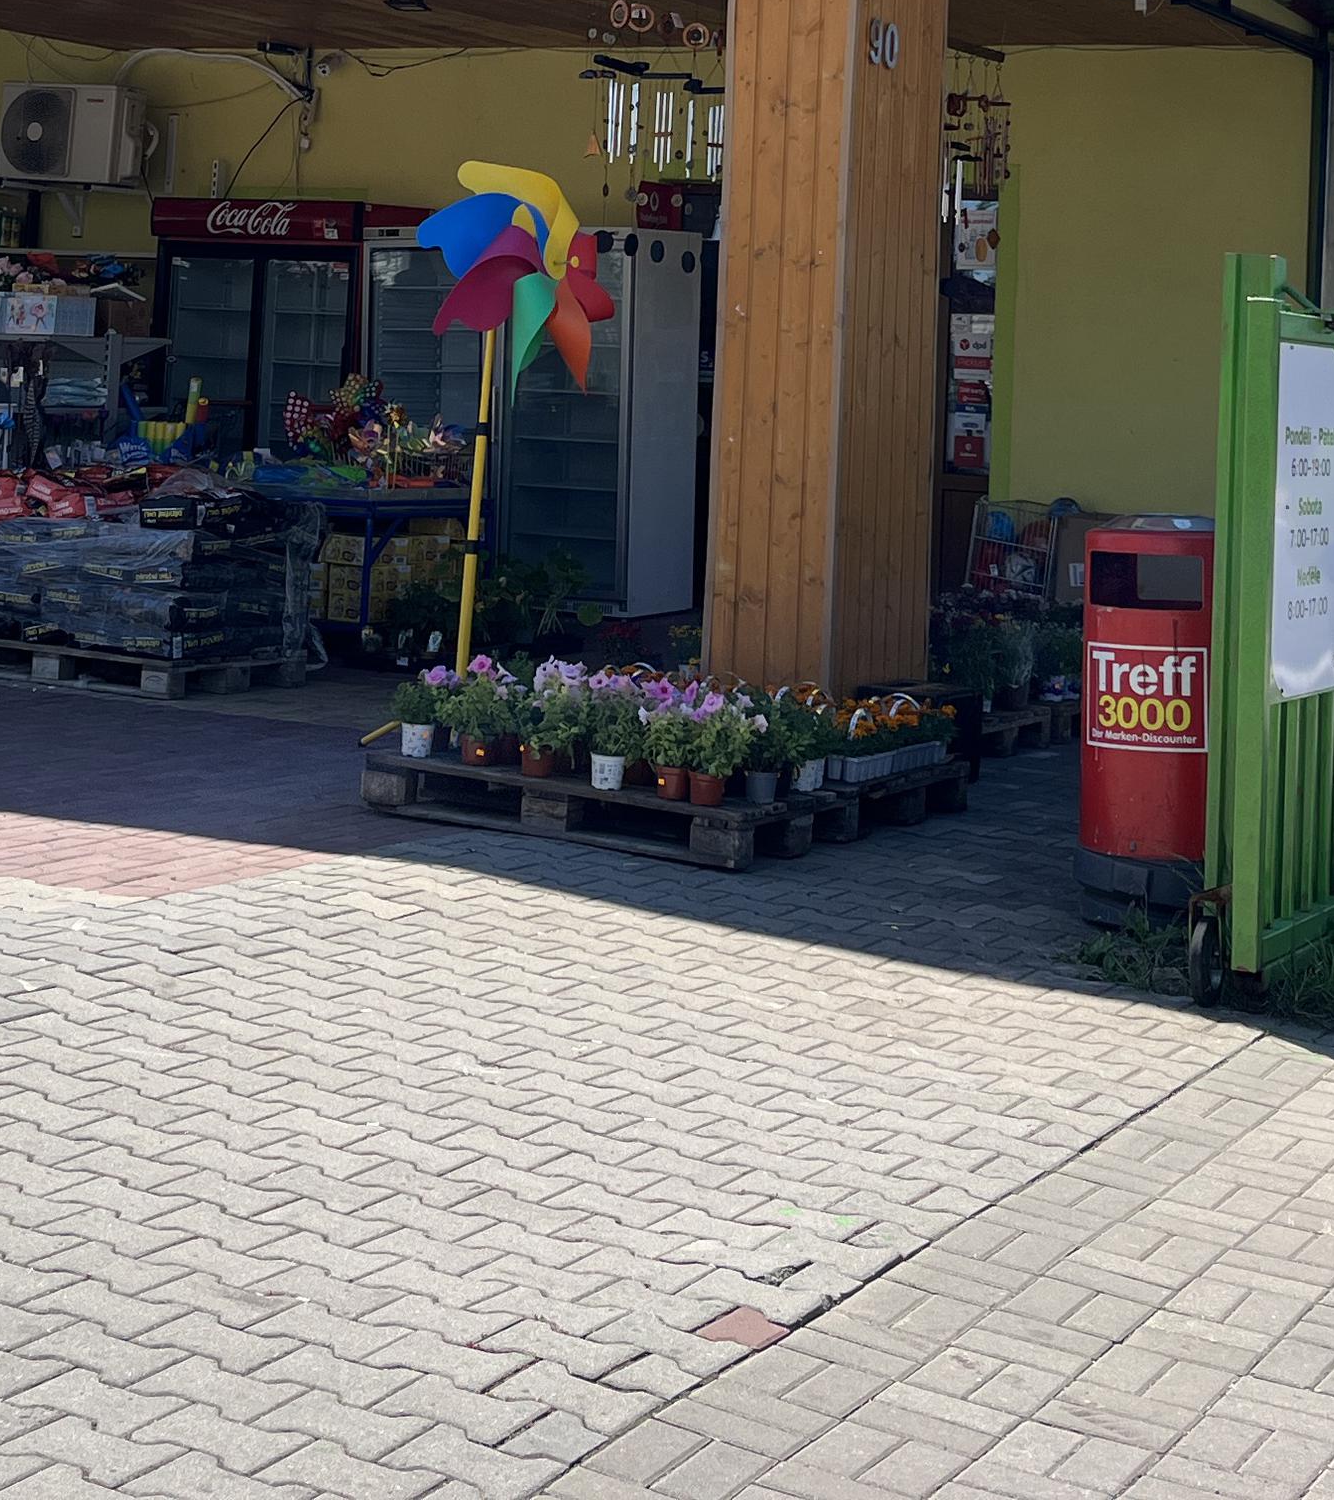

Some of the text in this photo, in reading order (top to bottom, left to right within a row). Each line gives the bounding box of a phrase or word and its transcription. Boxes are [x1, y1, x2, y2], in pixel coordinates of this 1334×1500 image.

[869, 18, 899, 69] 90
[206, 201, 298, 236] Coca-Cola
[1298, 497, 1322, 516] Sobota
[1297, 566, 1321, 587] Neděle
[1092, 651, 1197, 697] Treff
[1099, 695, 1192, 732] 3000
[1105, 730, 1198, 744] Marken-Discounter
